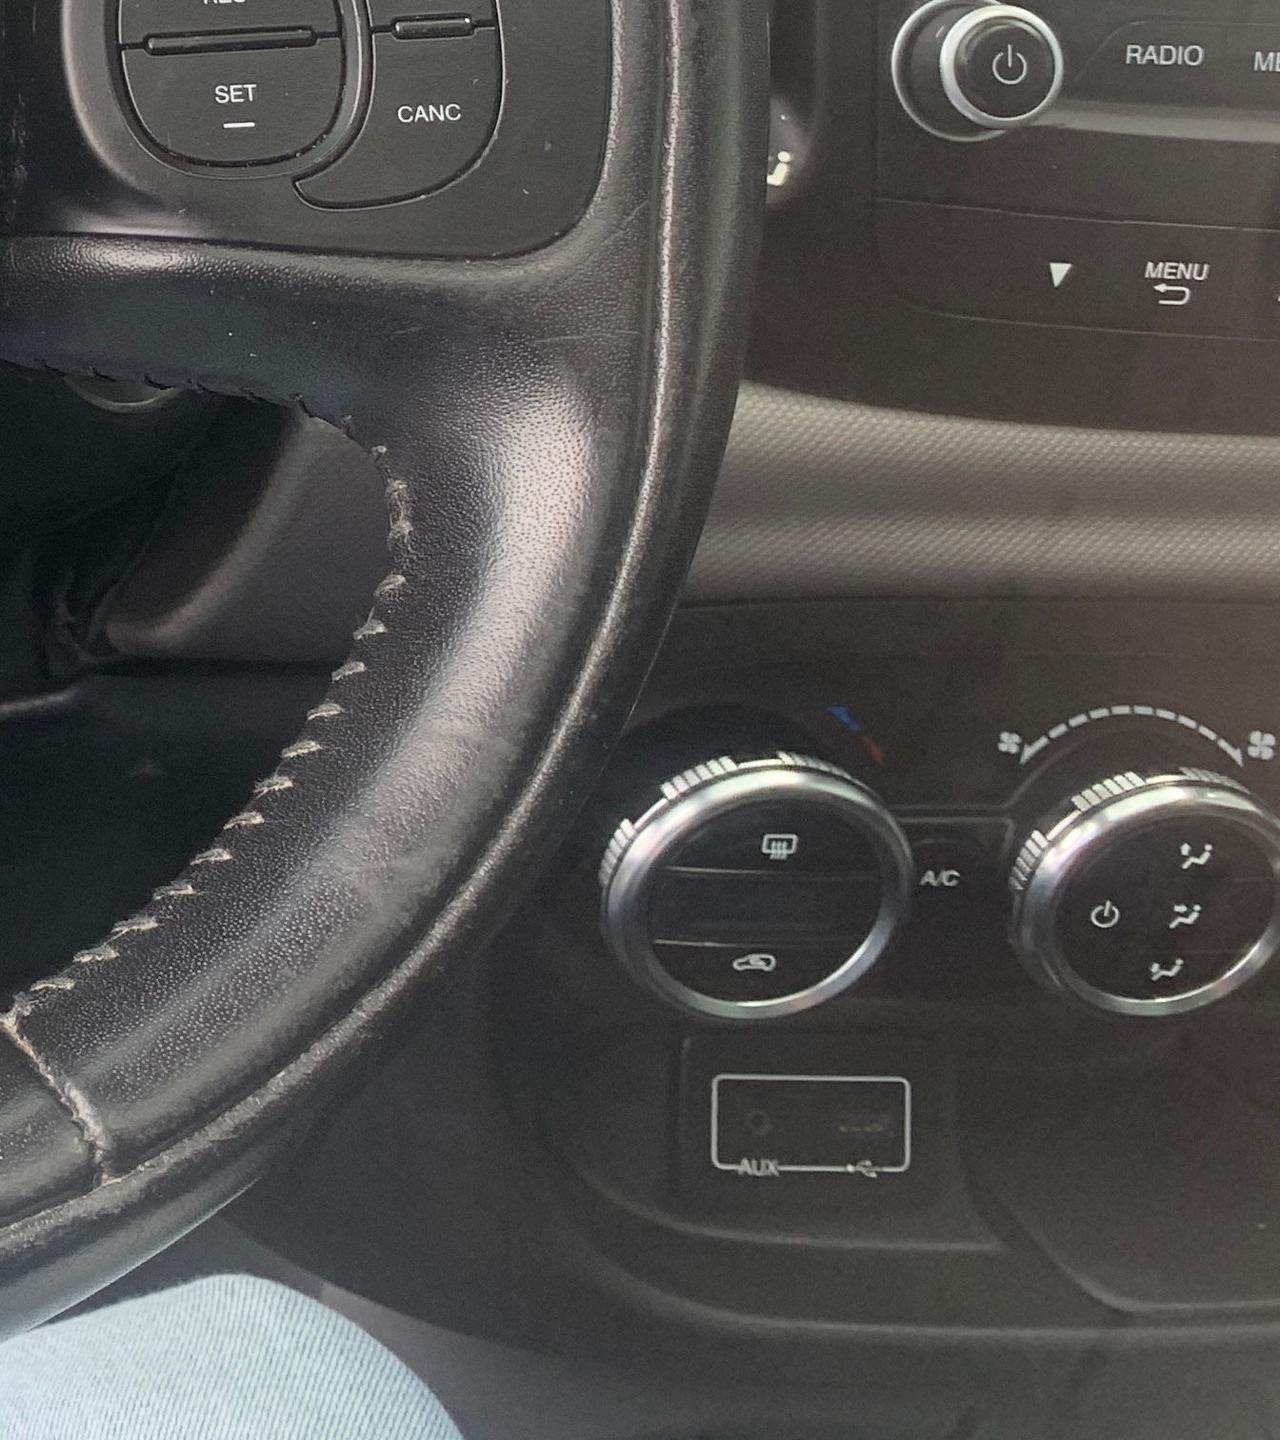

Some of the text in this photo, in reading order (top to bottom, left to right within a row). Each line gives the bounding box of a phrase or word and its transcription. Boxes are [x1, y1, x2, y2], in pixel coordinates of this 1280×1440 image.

[1125, 43, 1204, 67] RADIO
[214, 83, 258, 104] SET
[396, 104, 462, 124] CANC
[1144, 261, 1210, 281] MENU
[736, 1157, 780, 1177] AUX
